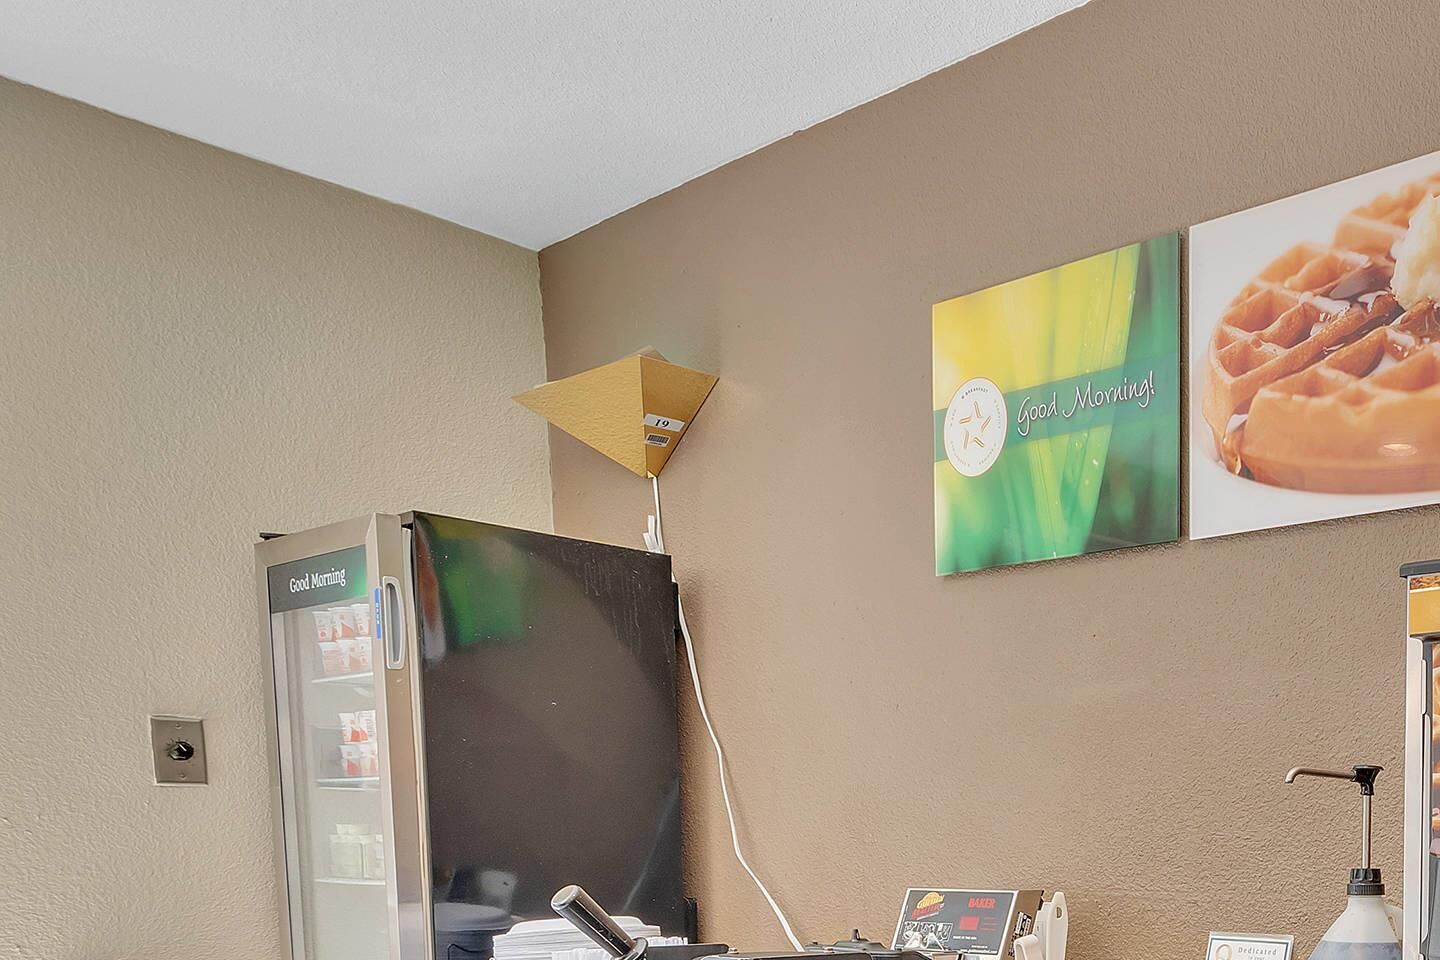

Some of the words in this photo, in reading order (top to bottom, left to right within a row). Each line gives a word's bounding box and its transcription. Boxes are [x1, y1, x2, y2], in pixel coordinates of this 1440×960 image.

[1016, 392, 1058, 436] Good
[1062, 370, 1156, 418] Morning!
[289, 573, 310, 593] Good
[311, 567, 347, 589] Morning
[968, 897, 996, 909] BAKER
[1238, 946, 1277, 956] Dedicated
